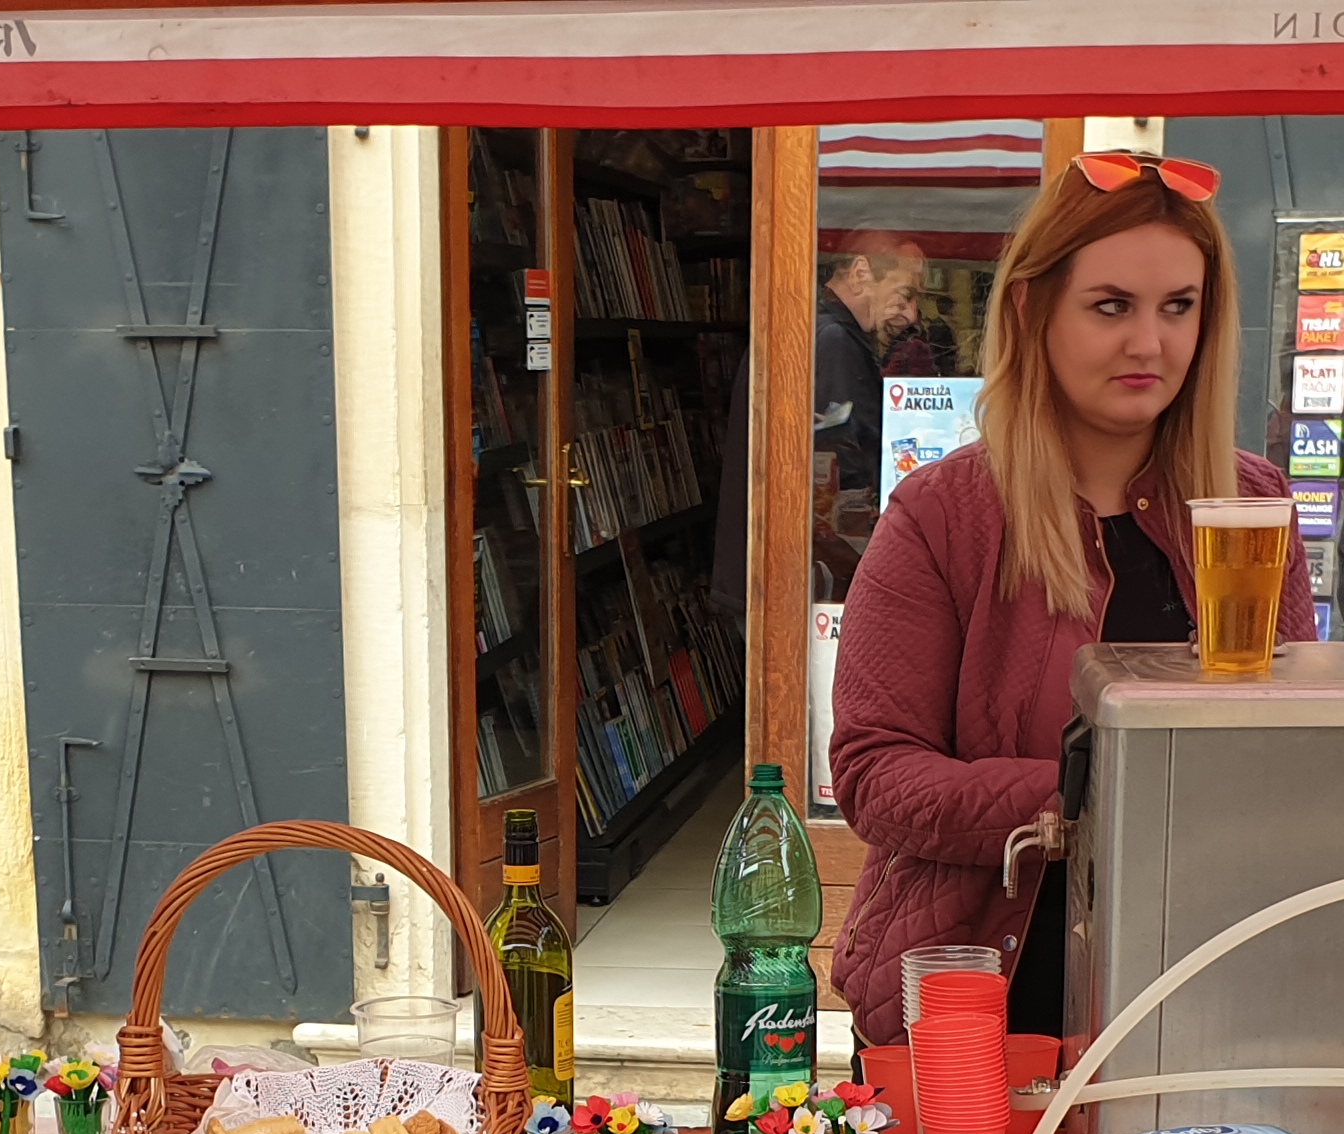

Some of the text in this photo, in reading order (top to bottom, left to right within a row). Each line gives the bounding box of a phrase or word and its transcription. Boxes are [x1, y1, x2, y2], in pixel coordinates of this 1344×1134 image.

[1301, 318, 1341, 331] TISAK
[1301, 331, 1340, 343] PAKET
[1301, 367, 1337, 379] PLATI
[906, 384, 951, 396] NAJBLIŽA
[904, 397, 954, 411] AKCIJA
[1292, 439, 1338, 455] CASH
[1292, 491, 1334, 503] MONEY
